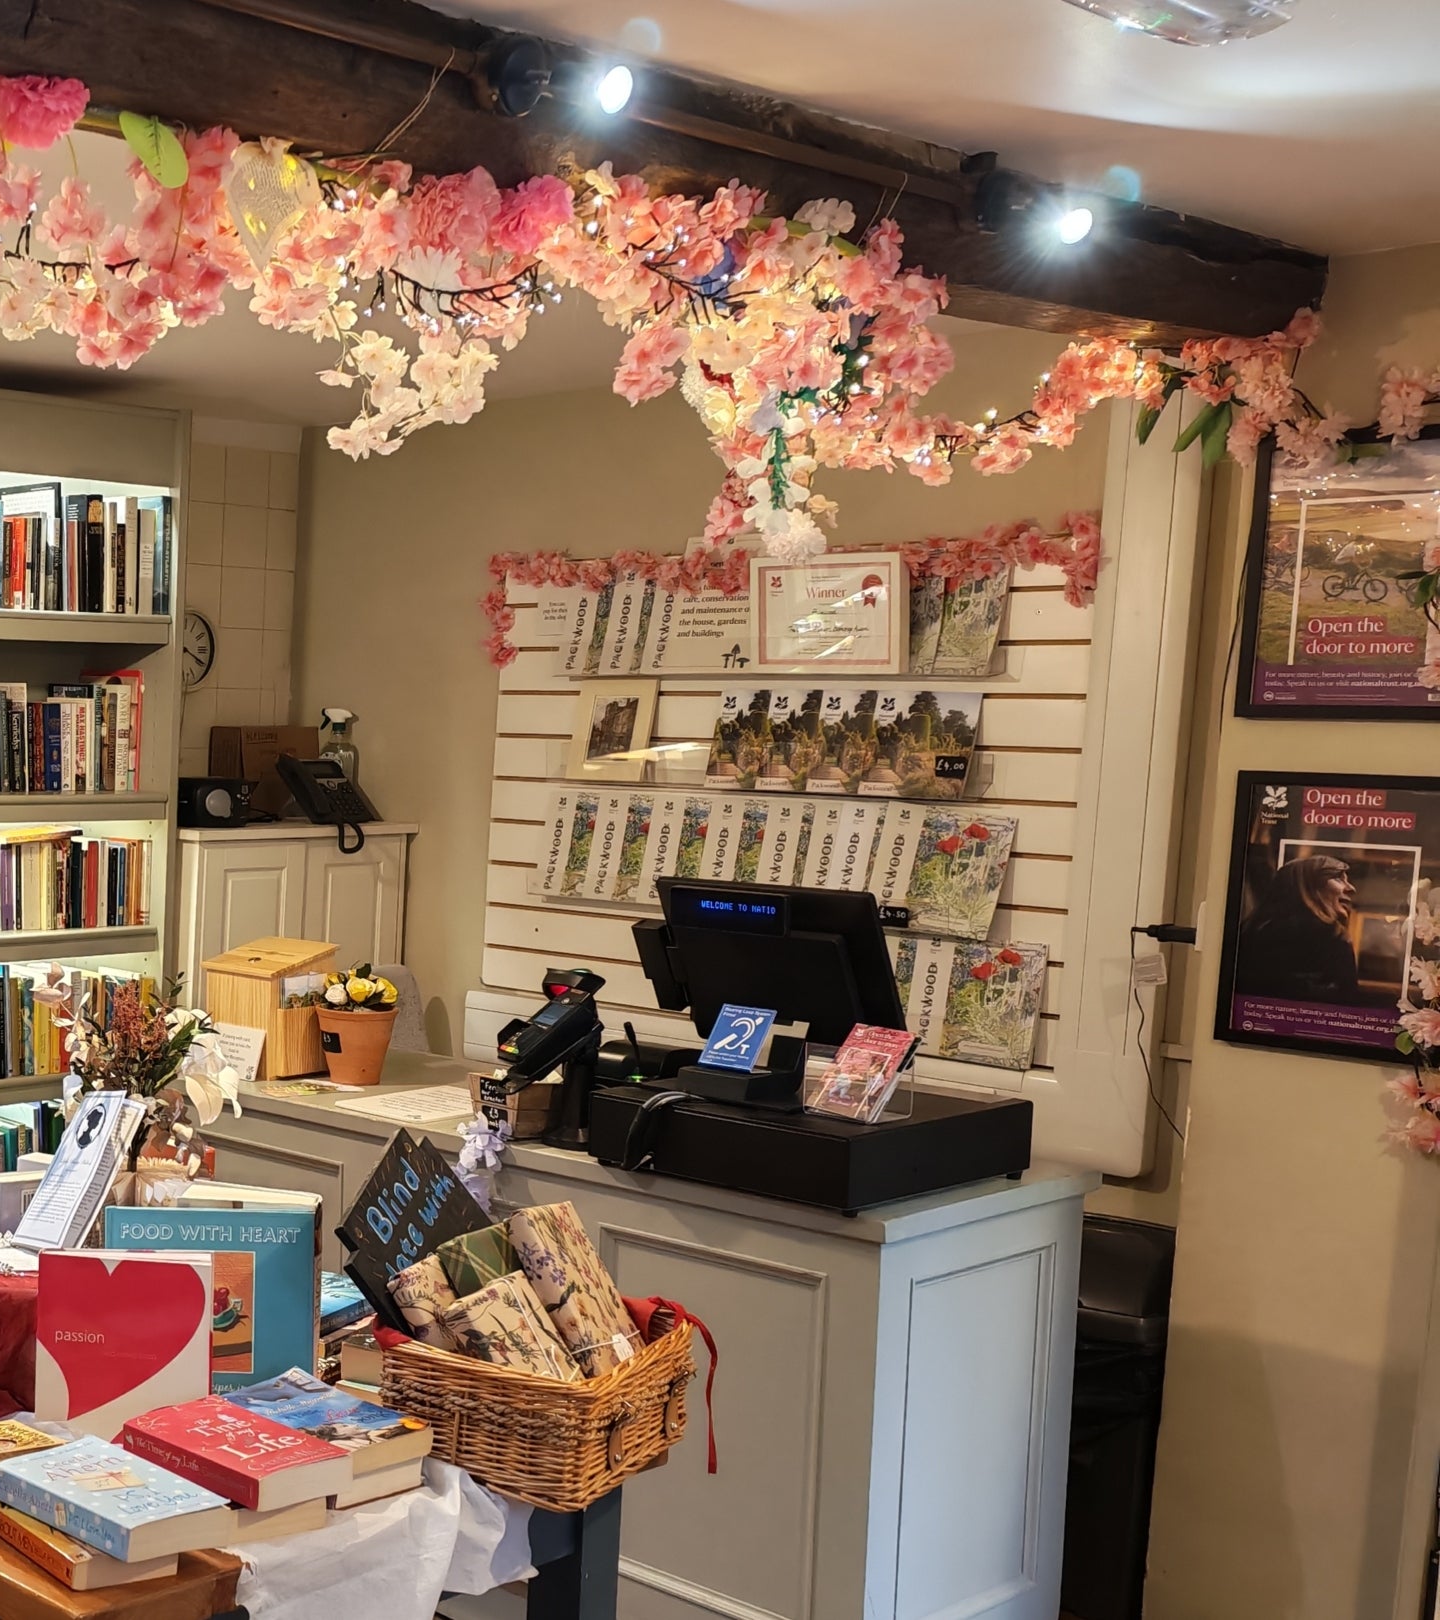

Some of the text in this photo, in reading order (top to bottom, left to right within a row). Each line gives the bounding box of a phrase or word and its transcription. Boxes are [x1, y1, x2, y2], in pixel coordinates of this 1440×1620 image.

[682, 593, 750, 605] care, conservation
[806, 586, 847, 600] Winner
[609, 592, 633, 671] PACKWOOD
[651, 592, 676, 670] PACKWOOD
[678, 616, 748, 628] the house, gardens
[1308, 617, 1384, 637] Open the
[564, 596, 589, 671] PACKWOOD
[676, 628, 725, 641] and buildings
[1306, 639, 1415, 655] door to more
[118, 692, 128, 724] MARR
[11, 713, 22, 750] Kennedys
[936, 759, 966, 772] £4.00
[1306, 789, 1382, 808] Open the
[1261, 811, 1289, 819] National
[1304, 810, 1412, 829] door to more
[543, 817, 564, 890] PACKWOOD
[594, 820, 616, 895] PACKWOOD
[711, 826, 730, 878] KWOOD
[769, 829, 788, 884] KWOOD
[815, 832, 834, 887] KWOOD
[701, 900, 734, 911] WELCOME
[738, 903, 748, 912] TO
[879, 906, 908, 920] £4.50
[1324, 1011, 1339, 1019] and
[366, 1156, 420, 1245] Blind
[418, 1173, 455, 1227] with
[120, 1222, 302, 1245] FOOD WITH HEART
[54, 1328, 106, 1345] passion
[186, 1418, 248, 1438] Time
[193, 1416, 214, 1427] The
[226, 1427, 256, 1442] of my
[135, 1436, 147, 1449] The
[146, 1440, 164, 1457] Time
[171, 1452, 181, 1468] my
[180, 1455, 202, 1473] Life
[217, 1433, 307, 1461] Life
[46, 1456, 126, 1482] Ahern
[117, 1491, 200, 1516] Love You
